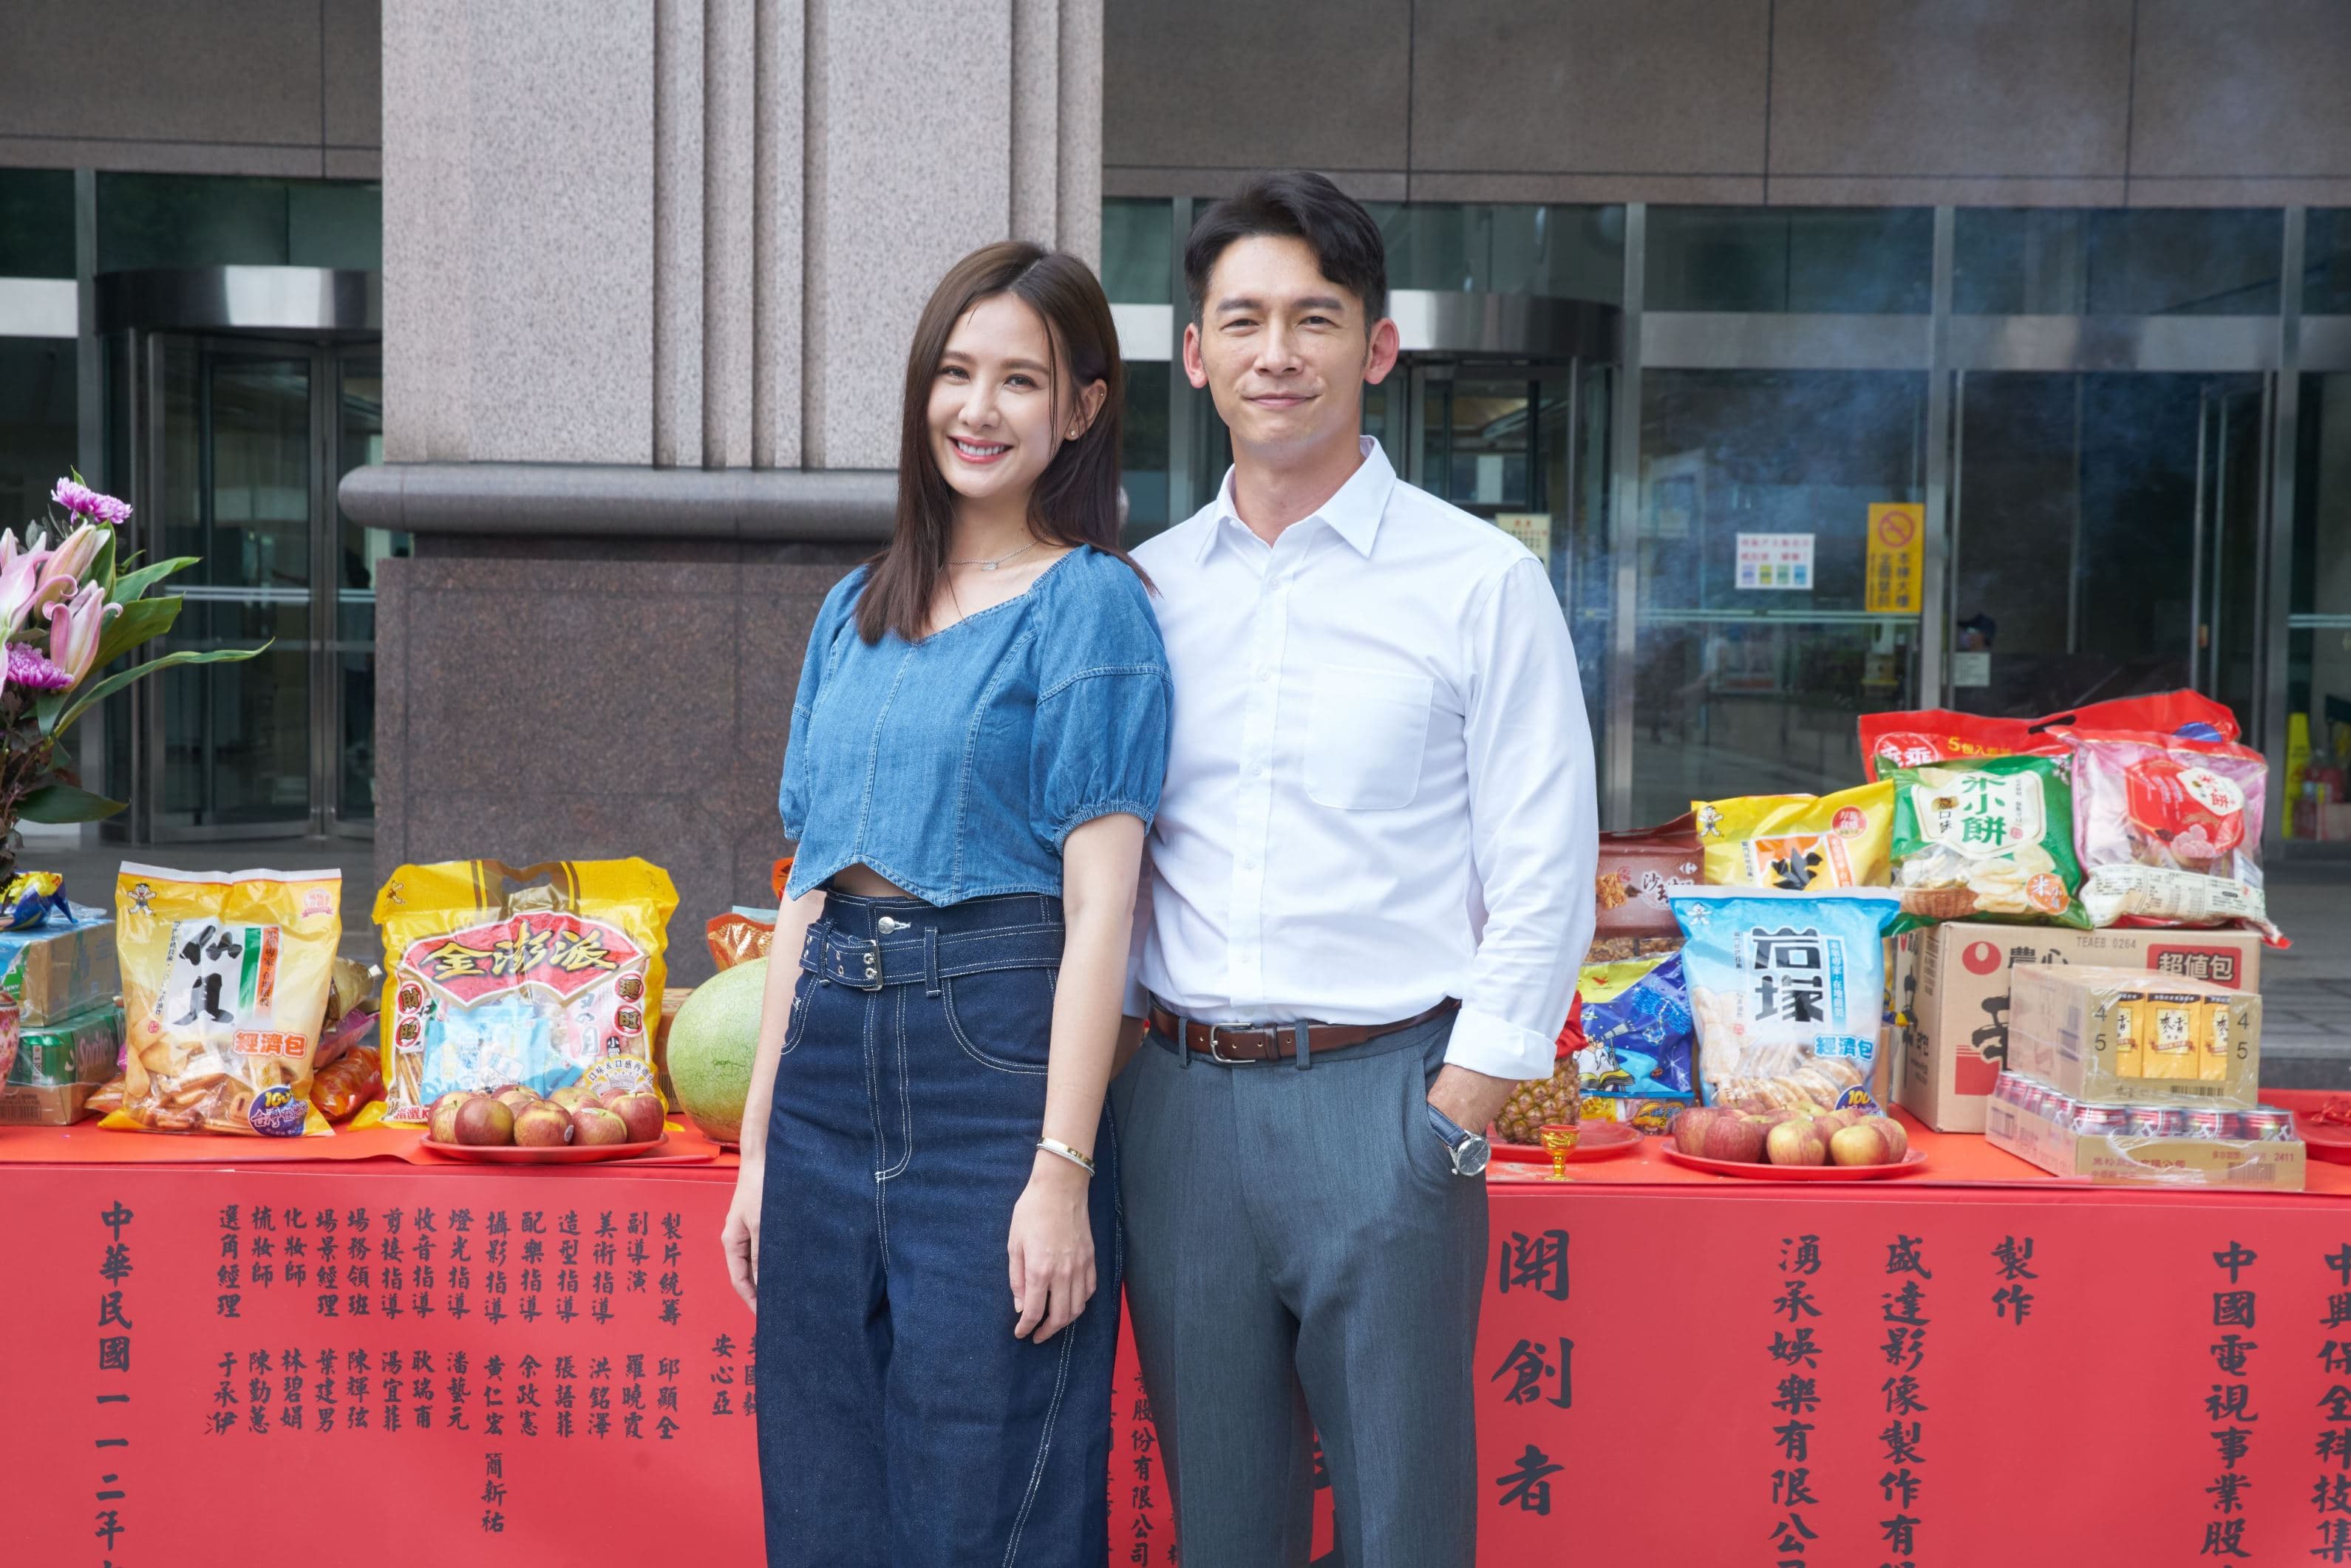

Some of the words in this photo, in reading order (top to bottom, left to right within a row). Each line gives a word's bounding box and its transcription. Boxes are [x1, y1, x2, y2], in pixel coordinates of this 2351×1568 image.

[1752, 927, 1823, 1023] 岩塚
[2157, 952, 2234, 981] 超值包
[235, 1032, 306, 1057] 經濟包
[1815, 1035, 1874, 1060] 經濟包
[2093, 1006, 2107, 1021] 4
[2095, 1034, 2106, 1051] 5
[2236, 1012, 2250, 1029] 4
[2236, 1042, 2248, 1060] 5
[2274, 1153, 2295, 1162] 2411
[217, 1205, 240, 1318] 選角經理
[285, 1208, 307, 1286] 化妝師
[316, 1209, 338, 1317] 場景經理
[347, 1208, 370, 1315] 場務領班
[381, 1208, 404, 1319] 剪接指導
[413, 1208, 436, 1318] 收音指導
[449, 1210, 473, 1319] 燈光指導
[486, 1212, 508, 1324] 攝影指導
[520, 1212, 545, 1322] 配樂指導
[557, 1211, 579, 1323] 造型指導
[593, 1211, 616, 1324] 美術指導
[627, 1212, 649, 1292] 副導演
[1992, 1235, 2038, 1325] 製作
[95, 1201, 134, 1568] 中華民國一一二年
[316, 1349, 337, 1432] 葉建男
[383, 1351, 403, 1431] 湯宜菲
[484, 1355, 505, 1435] 黃仁宏
[517, 1355, 541, 1436] 余政憲
[556, 1357, 576, 1437] 張語菲
[588, 1357, 610, 1438] 洪銘澤
[711, 1334, 735, 1415] 安心亞
[1491, 1230, 1574, 1516] 開創者
[1768, 1235, 1822, 1568] 湧承娛樂有限公
[1879, 1235, 1932, 1568] 盛達影像製作有
[2200, 1241, 2258, 1568] 中國電視事業股
